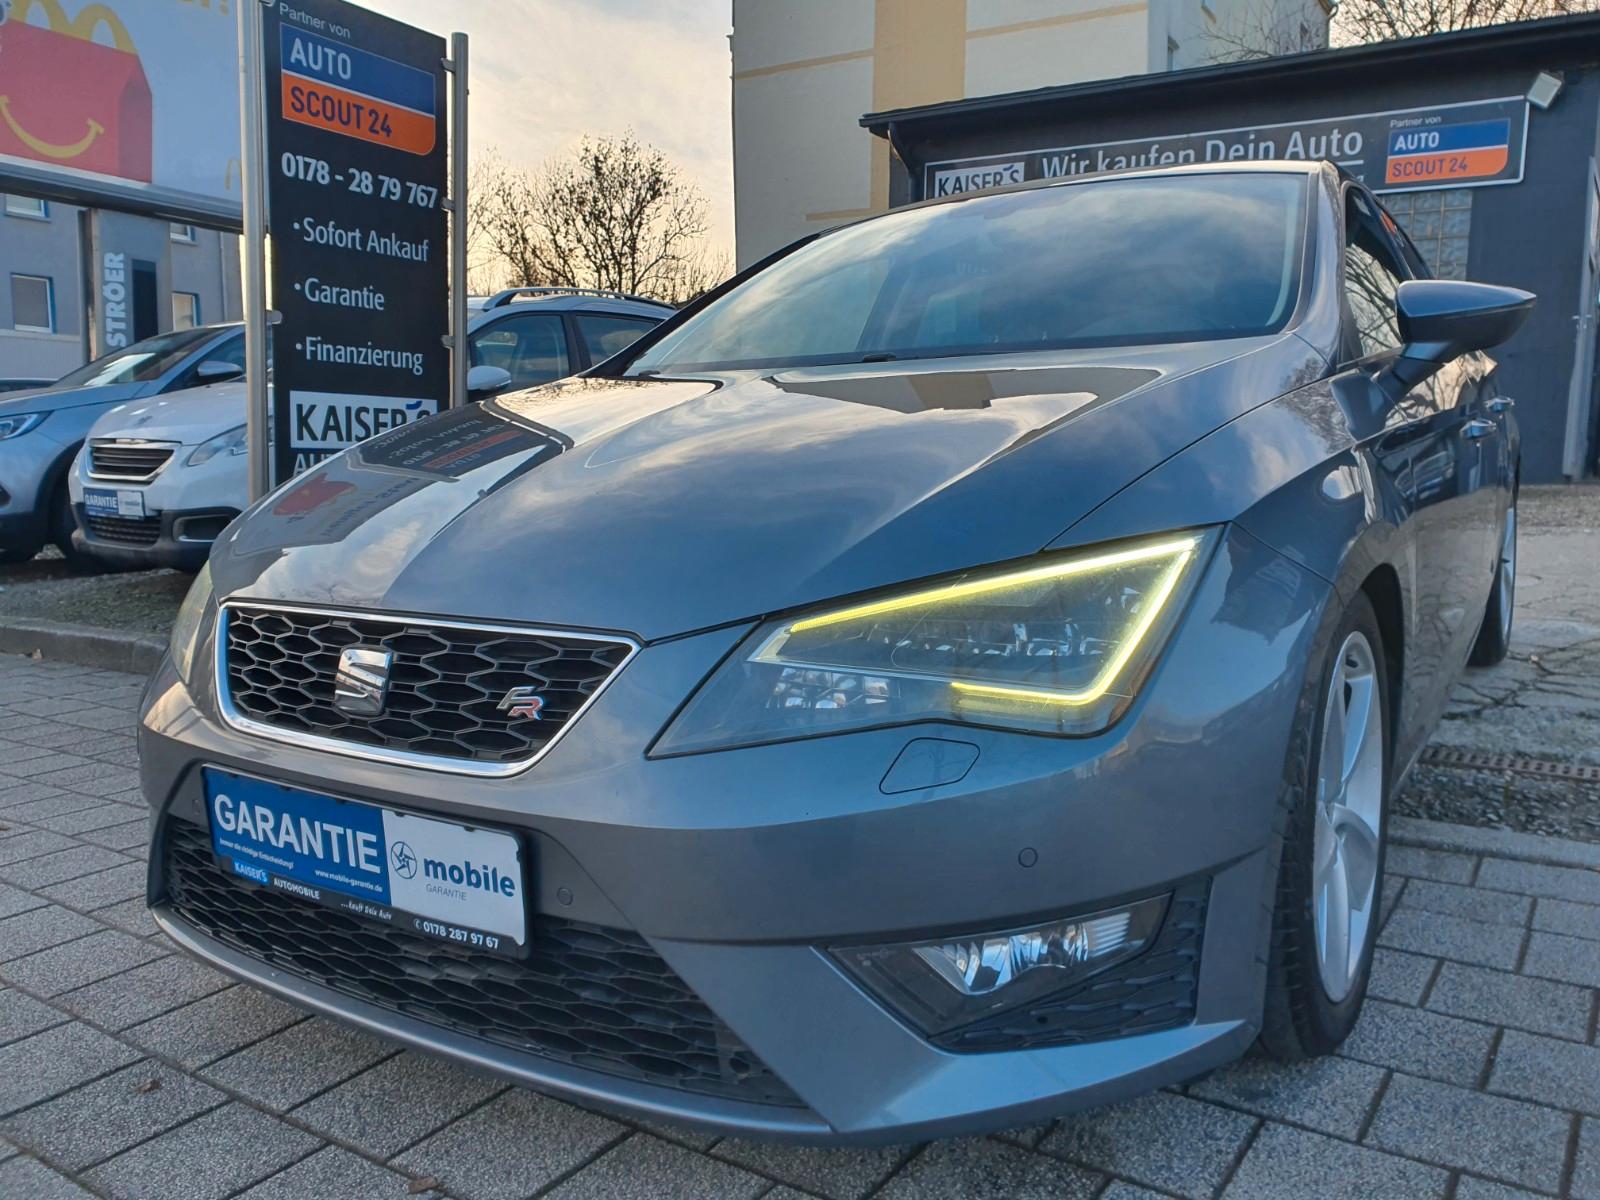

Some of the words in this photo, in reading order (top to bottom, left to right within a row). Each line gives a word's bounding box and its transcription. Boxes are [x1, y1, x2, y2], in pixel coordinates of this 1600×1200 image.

[279, 2, 325, 29] Partner
[329, 22, 351, 39] von
[290, 37, 352, 80] AUTO
[1390, 117, 1422, 128] Partner
[1425, 116, 1441, 124] von
[1042, 153, 1090, 178] Wir
[1097, 144, 1195, 172] kaufen
[1206, 134, 1275, 161] Dein
[1285, 128, 1363, 161] Auto
[1393, 131, 1440, 151] AUTO
[281, 152, 330, 185] 0178
[348, 168, 373, 195] 28
[379, 174, 401, 200] 79
[406, 181, 438, 209] 767
[303, 217, 362, 251] Sofort
[366, 230, 429, 262] Ankauf
[304, 277, 385, 311] Garantie
[305, 336, 423, 376] Finanzierung
[85, 494, 117, 508] GARANTIE
[214, 794, 381, 874] GARANTIE
[274, 878, 320, 900] AUTOMOBILE
[424, 858, 516, 897] mobile
[426, 883, 468, 901] GARANTIE
[423, 921, 447, 936] 0178
[448, 927, 467, 942] 287
[470, 932, 484, 945] 97
[486, 936, 499, 949] 67
